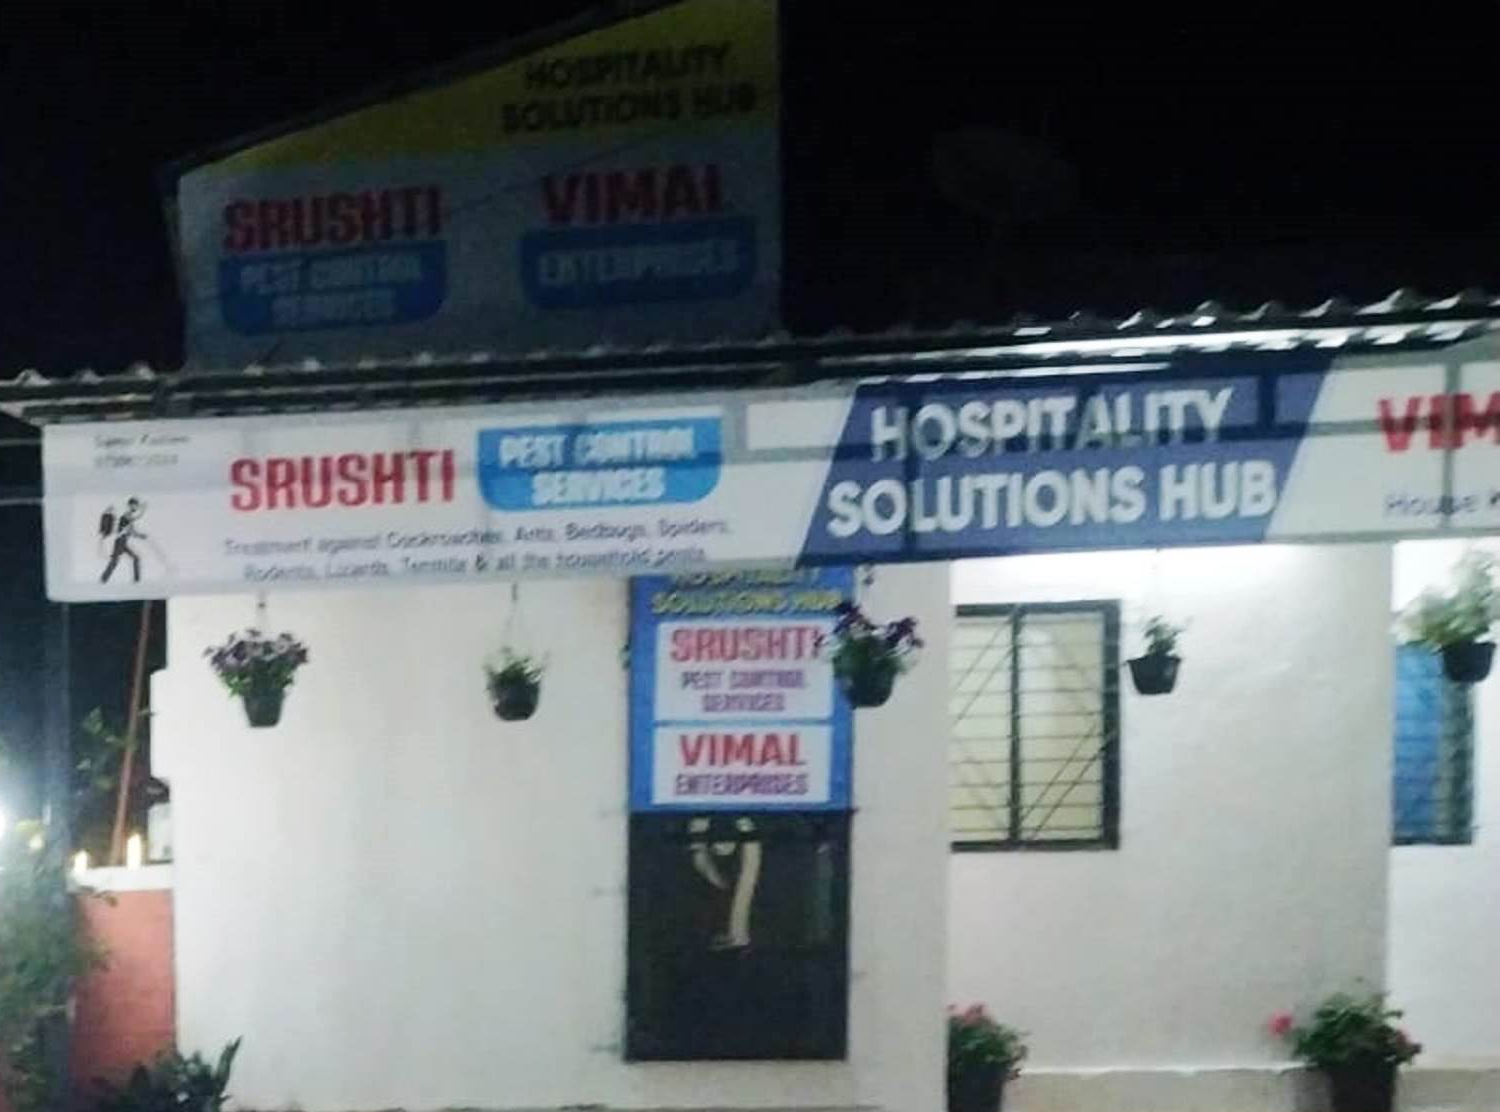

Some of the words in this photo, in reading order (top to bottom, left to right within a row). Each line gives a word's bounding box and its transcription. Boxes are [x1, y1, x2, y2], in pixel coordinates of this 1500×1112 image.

[523, 40, 732, 89] HOSPITALITY
[501, 87, 684, 134] SOLUTIONS
[690, 79, 758, 118] HUB
[540, 164, 727, 224] VIMAL
[223, 183, 443, 252] SRUSHTI
[239, 260, 304, 294] PEST
[310, 254, 423, 289] CONTROL
[537, 241, 743, 286] ENTERPRISES
[271, 287, 400, 321] SERVICES
[870, 387, 1234, 463] HOSPITALITY
[500, 434, 568, 468] PEST
[573, 427, 696, 466] CONTROL
[230, 448, 455, 512] SRUSHTI
[532, 466, 666, 506] SERVICES
[827, 464, 1147, 538] SOLUTIONS
[1157, 459, 1281, 522] HUB
[681, 670, 723, 689] PEST
[729, 669, 806, 689] CONTROL
[703, 693, 786, 713] SERVICES
[678, 733, 806, 767] VIMAL
[675, 773, 810, 797] ENTERPRISES
